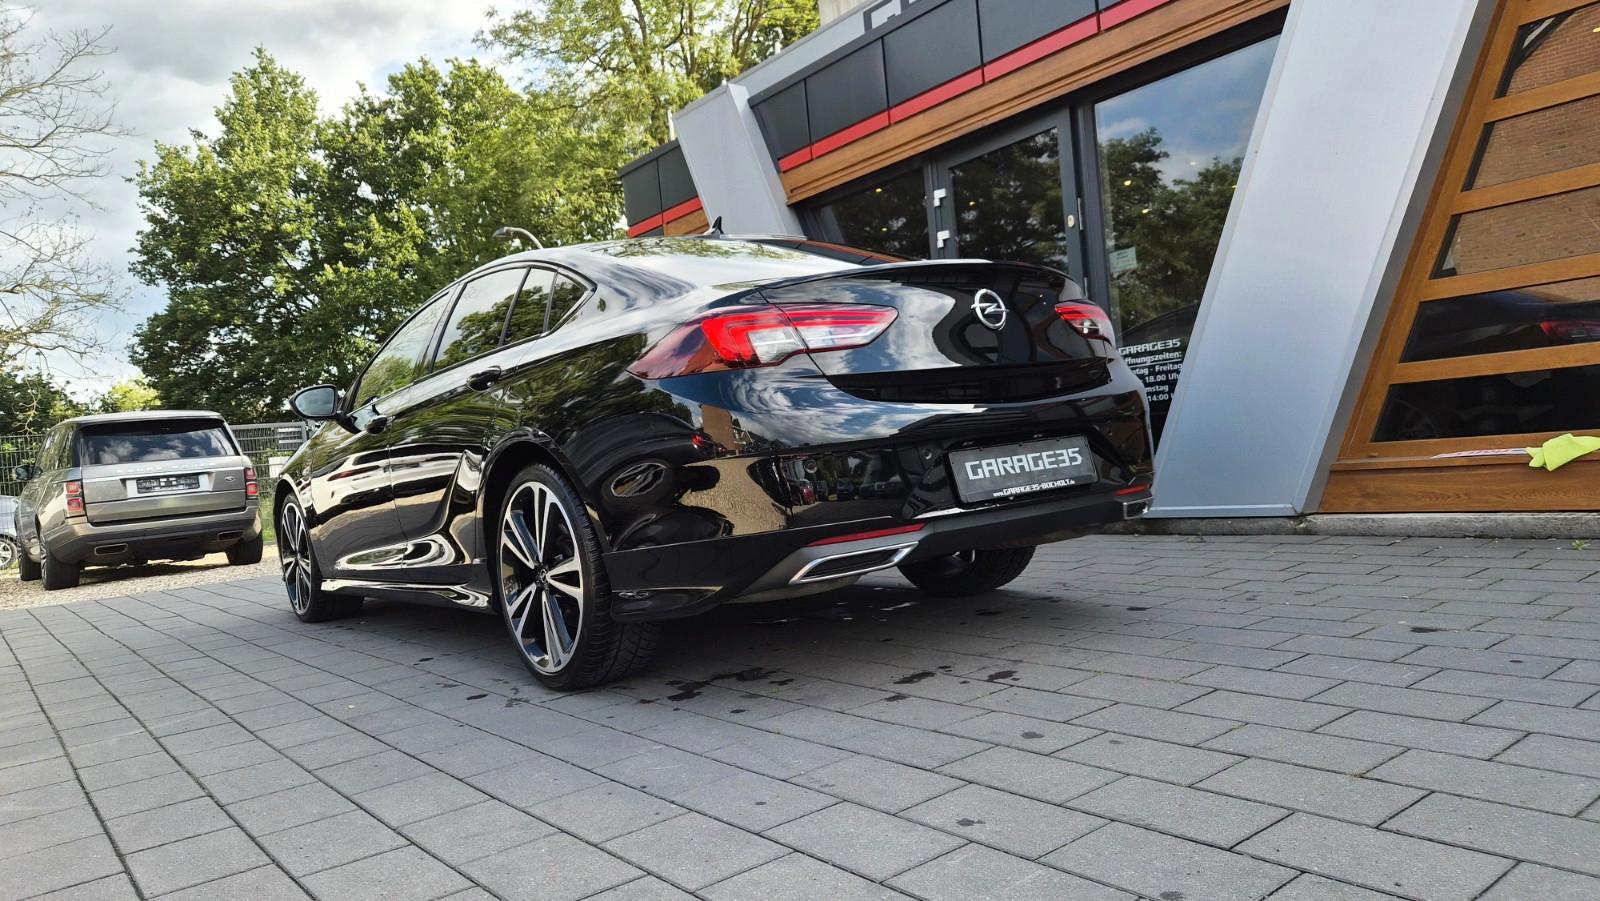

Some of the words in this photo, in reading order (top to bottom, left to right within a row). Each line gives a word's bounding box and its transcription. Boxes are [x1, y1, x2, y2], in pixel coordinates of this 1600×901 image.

[1119, 338, 1181, 356] GARAGE35
[1125, 351, 1182, 365] ffnungszeiten:
[964, 447, 1083, 480] GARAGE35
